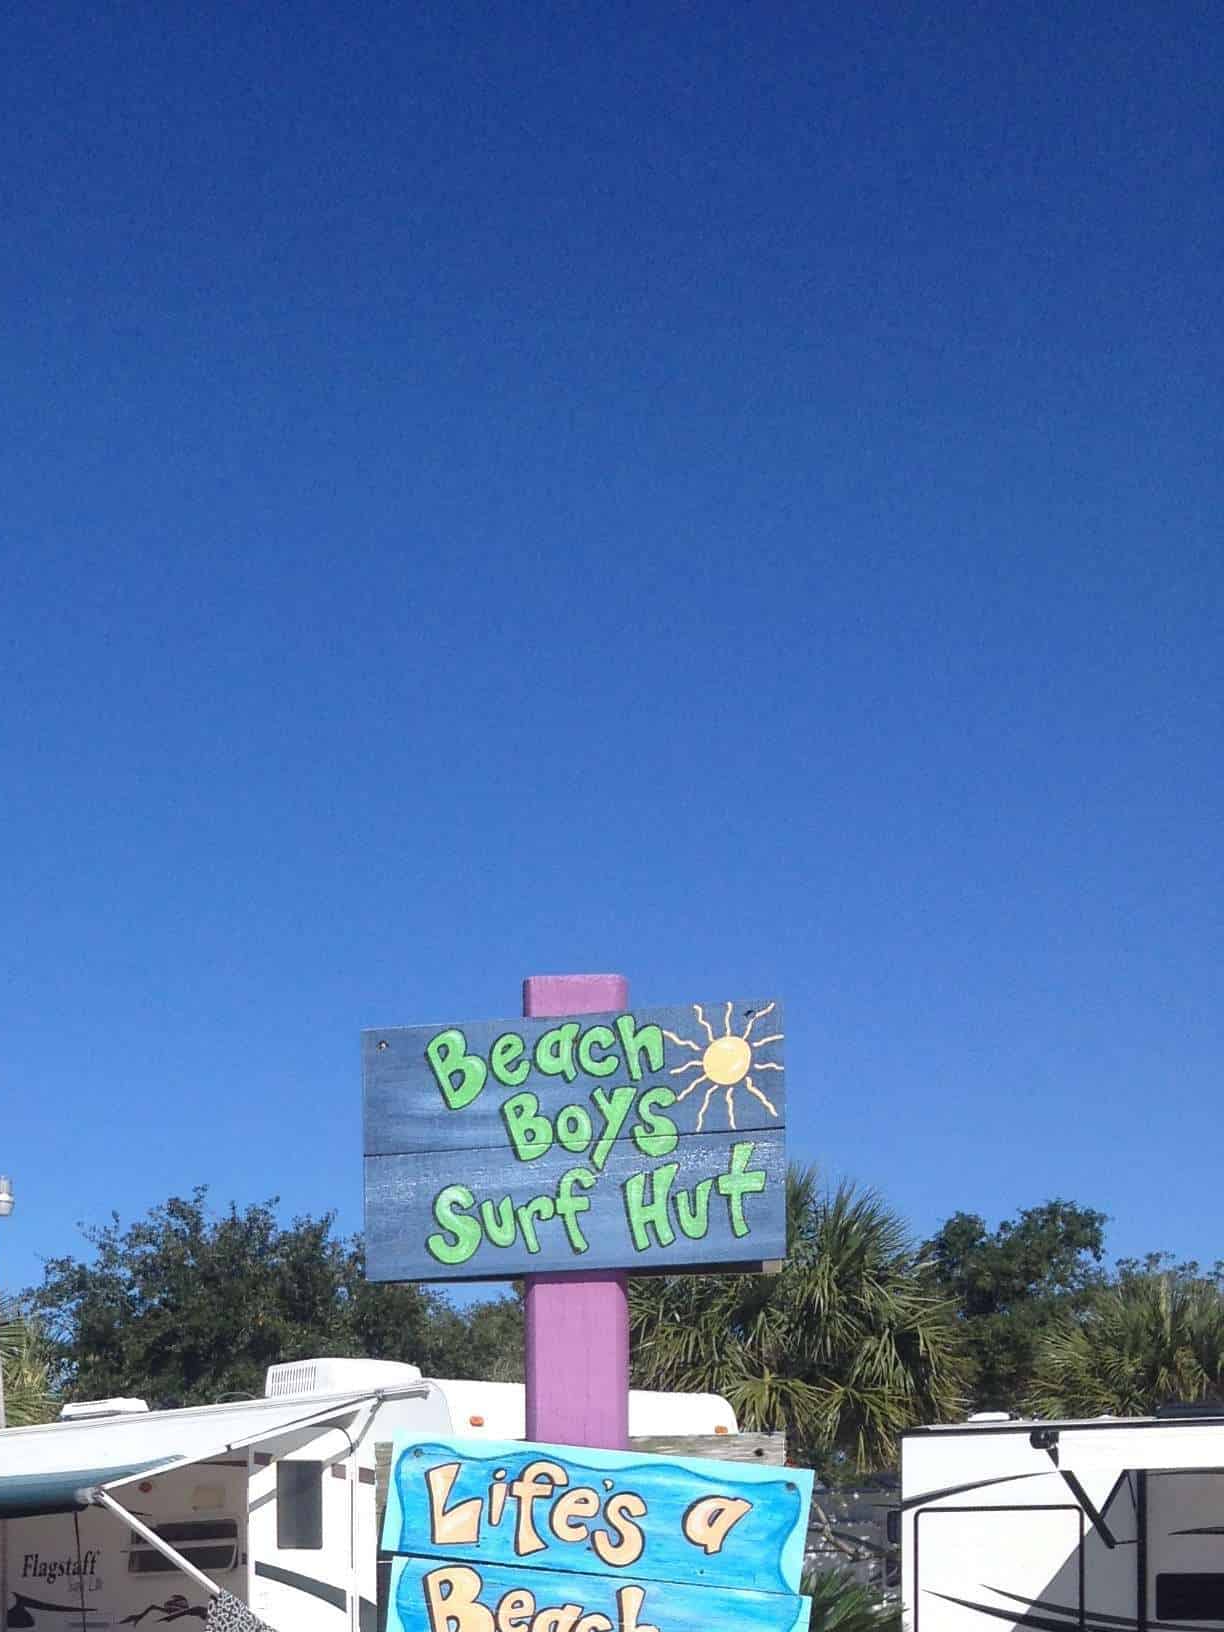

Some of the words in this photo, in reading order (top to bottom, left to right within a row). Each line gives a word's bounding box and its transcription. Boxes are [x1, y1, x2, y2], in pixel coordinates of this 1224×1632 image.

[426, 1014, 665, 1110] Beach
[500, 1086, 678, 1171] Boys
[426, 1167, 596, 1265] Surf
[623, 1142, 767, 1252] Hut
[425, 1460, 647, 1567] Life's
[682, 1494, 753, 1555] a
[22, 1550, 96, 1585] Flagstaff
